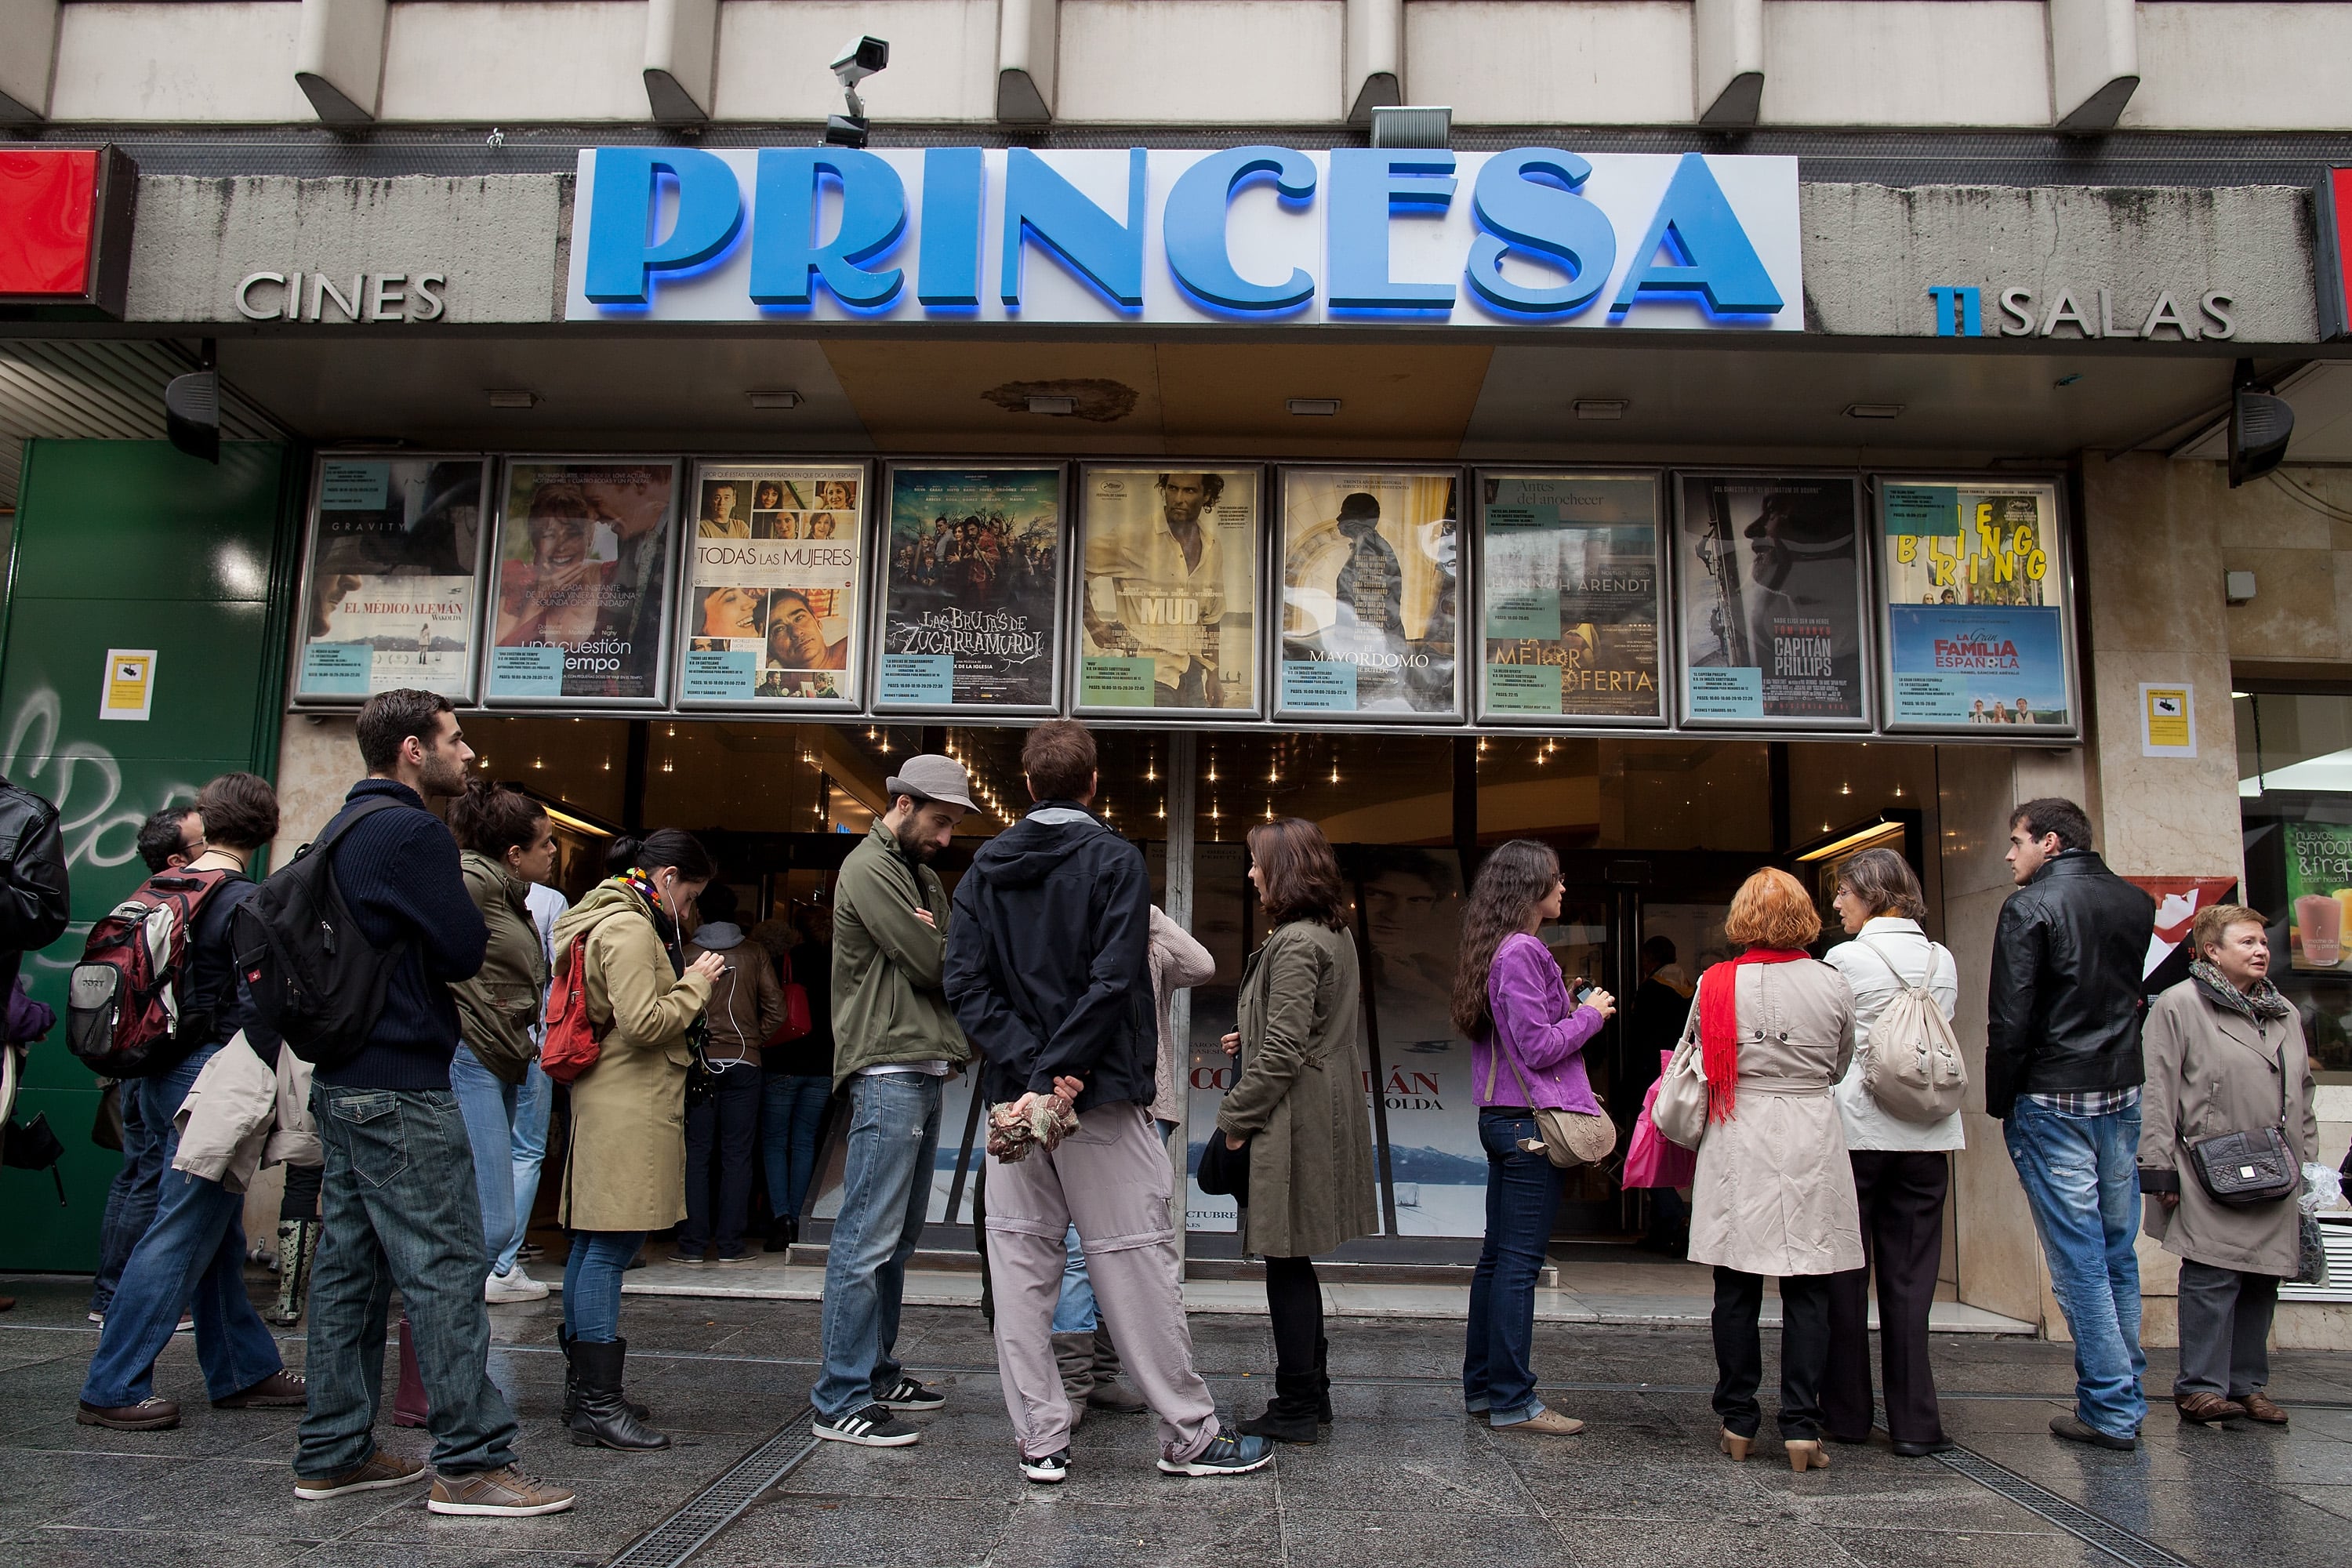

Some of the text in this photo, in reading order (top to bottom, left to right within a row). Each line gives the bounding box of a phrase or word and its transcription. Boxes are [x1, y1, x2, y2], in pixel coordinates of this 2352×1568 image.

[583, 145, 1785, 318] PRINCESA
[235, 271, 445, 321] CINES
[1929, 285, 2236, 339] 11 SALAS
[1517, 480, 1555, 492] Antes
[1517, 493, 1604, 506] del anochecer
[332, 522, 405, 532] GRAVITY
[1897, 525, 2033, 564] BLING
[698, 547, 852, 568] TODAS LAS MUJERES
[1936, 549, 2047, 586] RING
[1492, 577, 1650, 592] HANNAH ARENDT
[344, 600, 463, 614] EL MÉDICO ALEMÁN
[571, 599, 630, 608] OPORTUNIDAD?
[1141, 598, 1199, 625] MUD
[919, 607, 1028, 633] LAS BRUJAS DE
[1774, 626, 1831, 635] TOM HANKS
[1968, 628, 1998, 646] Gran
[558, 638, 631, 654] cuestión
[900, 626, 1045, 657] ZUGARRAMURDI
[1774, 635, 1831, 658] CAPITÁN
[1934, 640, 2019, 657] FAMILIA
[1309, 650, 1429, 668] MAYORDOMO
[1775, 657, 1831, 677] PHILLIPS
[1936, 656, 2020, 668] ESPAÑOLA
[2296, 831, 2333, 840] nuevos
